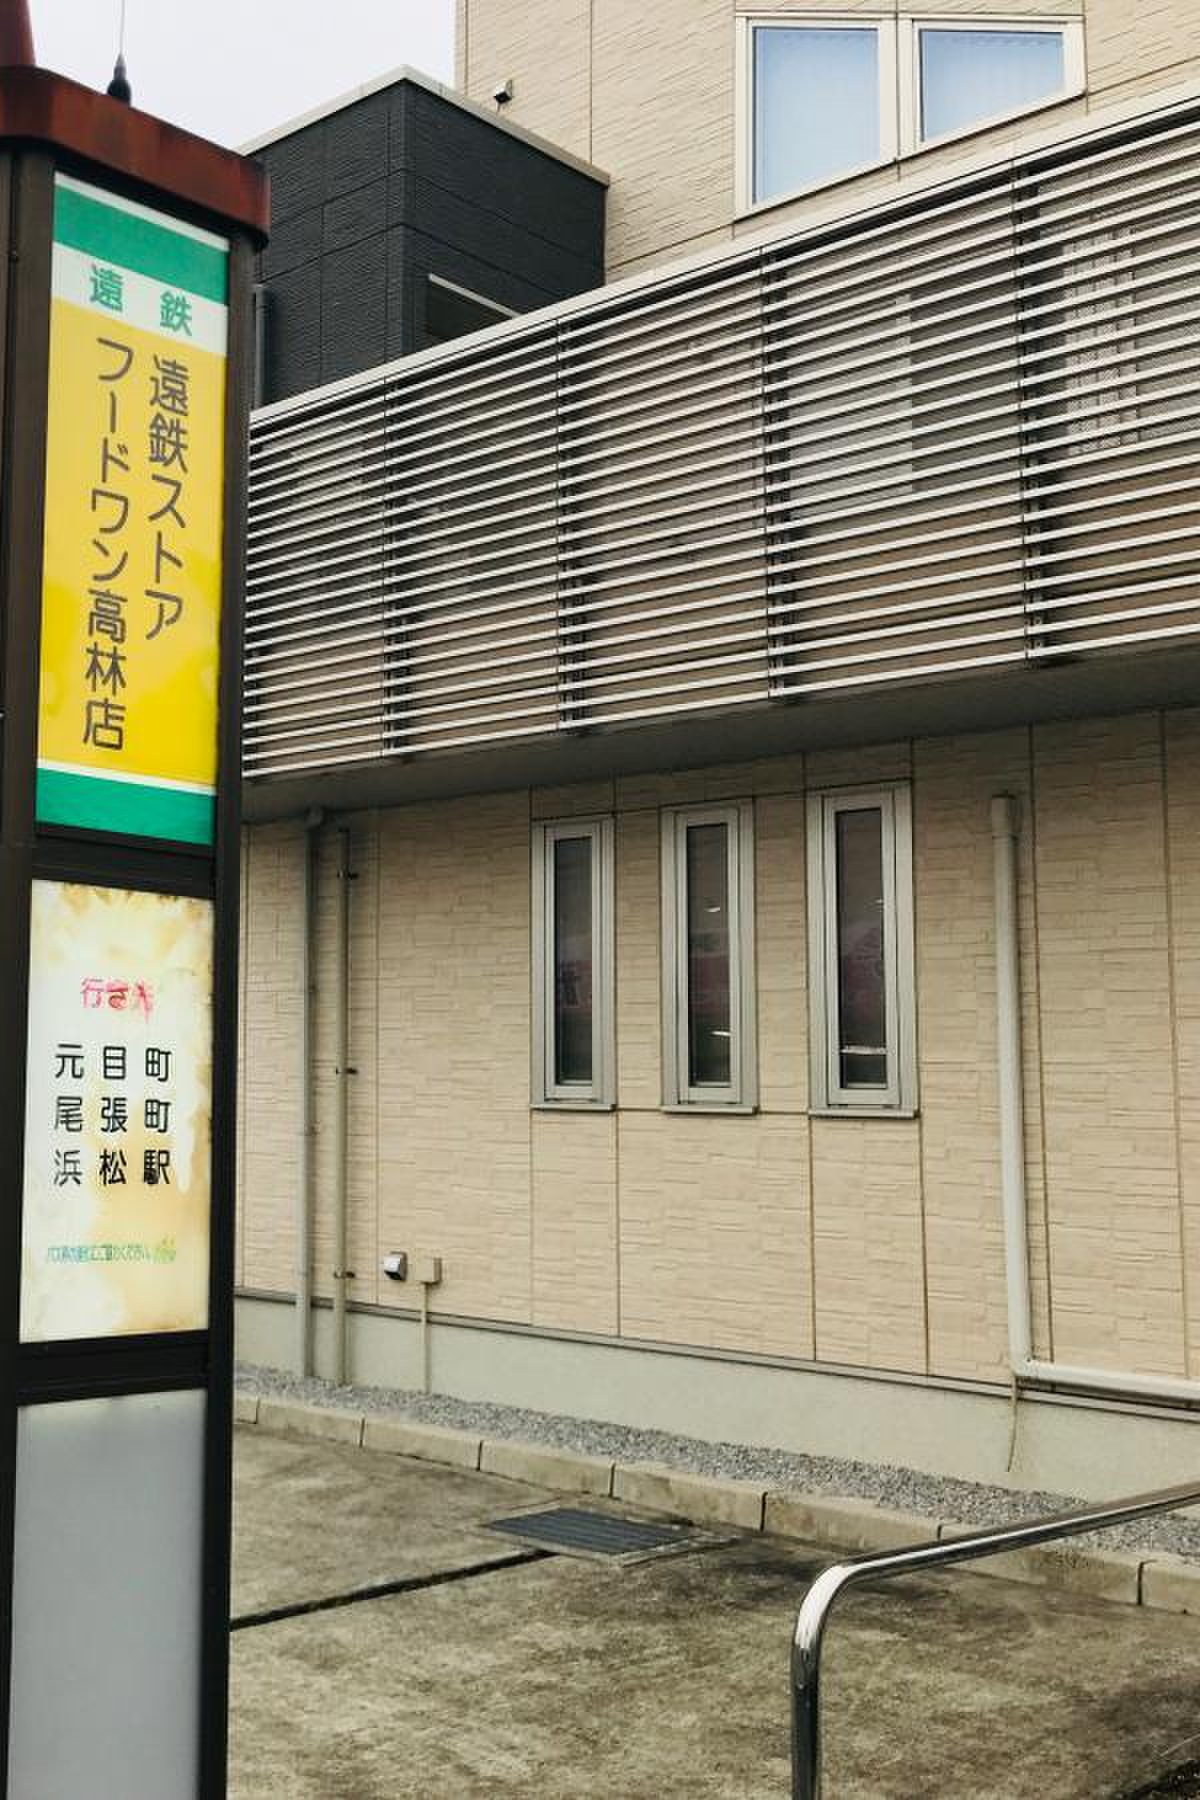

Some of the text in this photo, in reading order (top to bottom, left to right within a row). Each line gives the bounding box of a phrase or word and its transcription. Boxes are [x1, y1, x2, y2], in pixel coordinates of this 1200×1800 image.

[89, 263, 193, 337] 遠鉄
[145, 354, 190, 641] 遠鉄ストア
[82, 336, 134, 752] フードワン高林店
[55, 1043, 173, 1083] 元目町
[54, 1096, 173, 1133] 尾張町
[54, 1149, 171, 1187] 浜松駅
